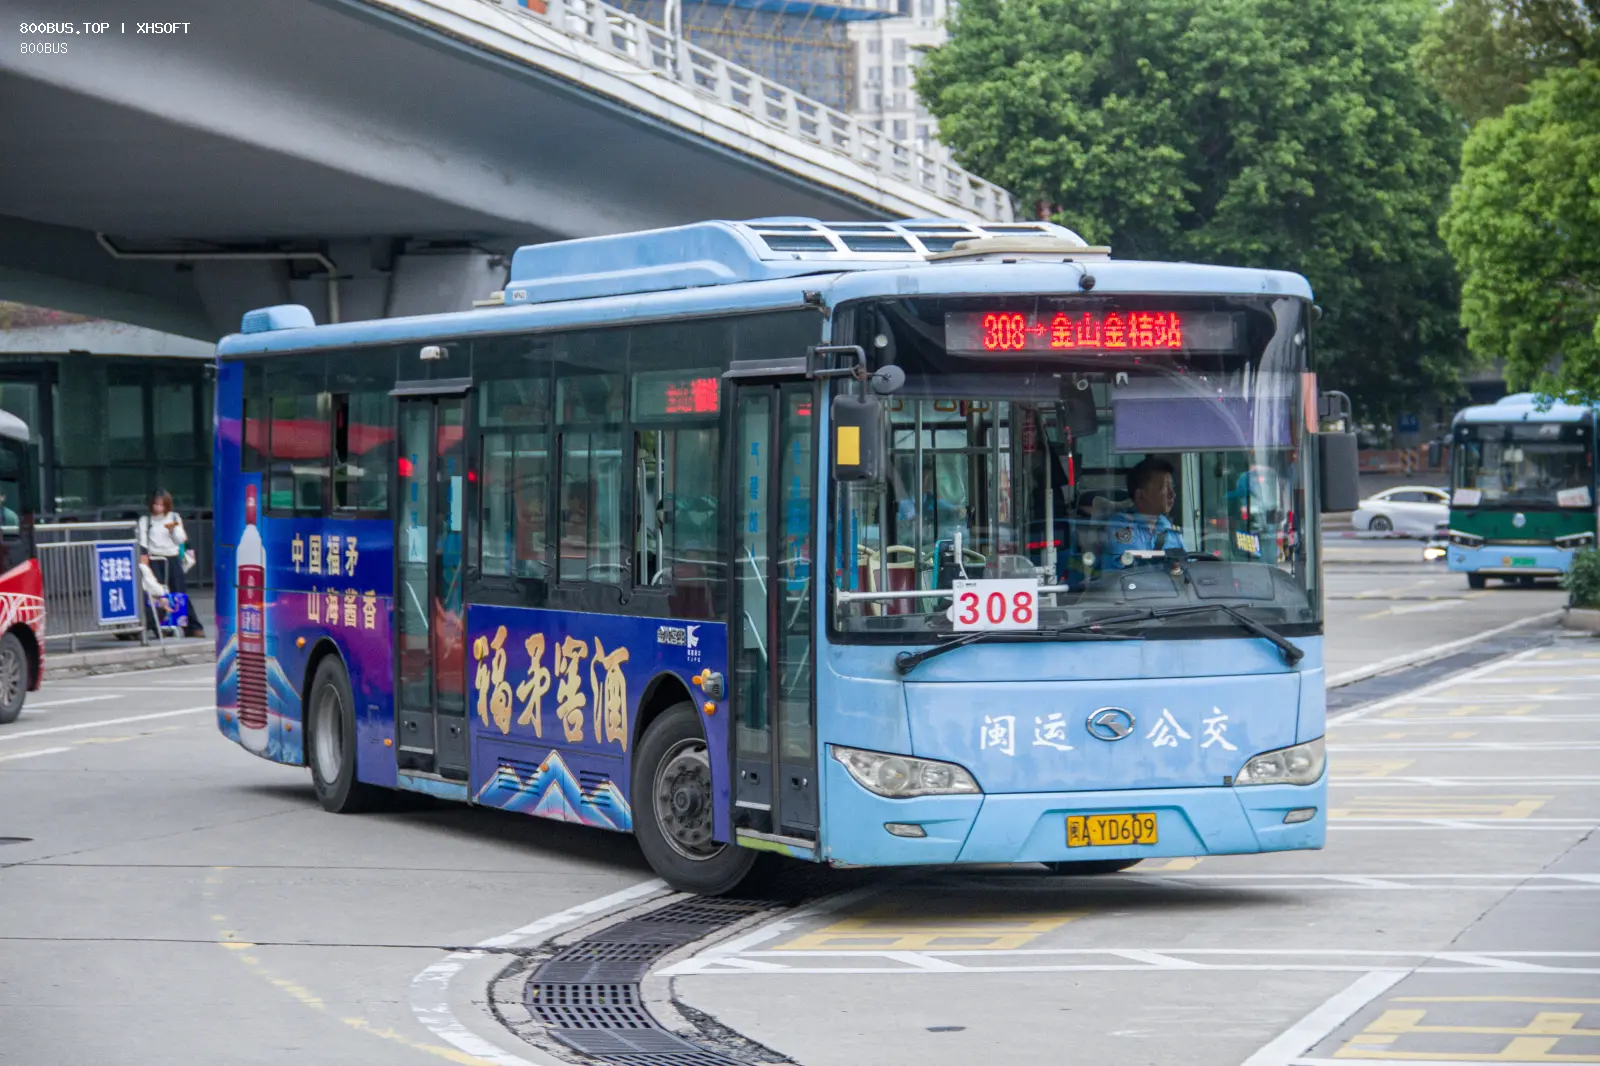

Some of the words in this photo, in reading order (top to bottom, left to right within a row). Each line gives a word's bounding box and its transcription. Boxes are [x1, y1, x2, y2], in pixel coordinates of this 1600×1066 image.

[984, 313, 1025, 350] 308
[1050, 312, 1181, 348] 金山金桔站
[292, 533, 358, 576] 中国福矛
[308, 585, 376, 629] 山海酱香
[959, 591, 1032, 624] 308
